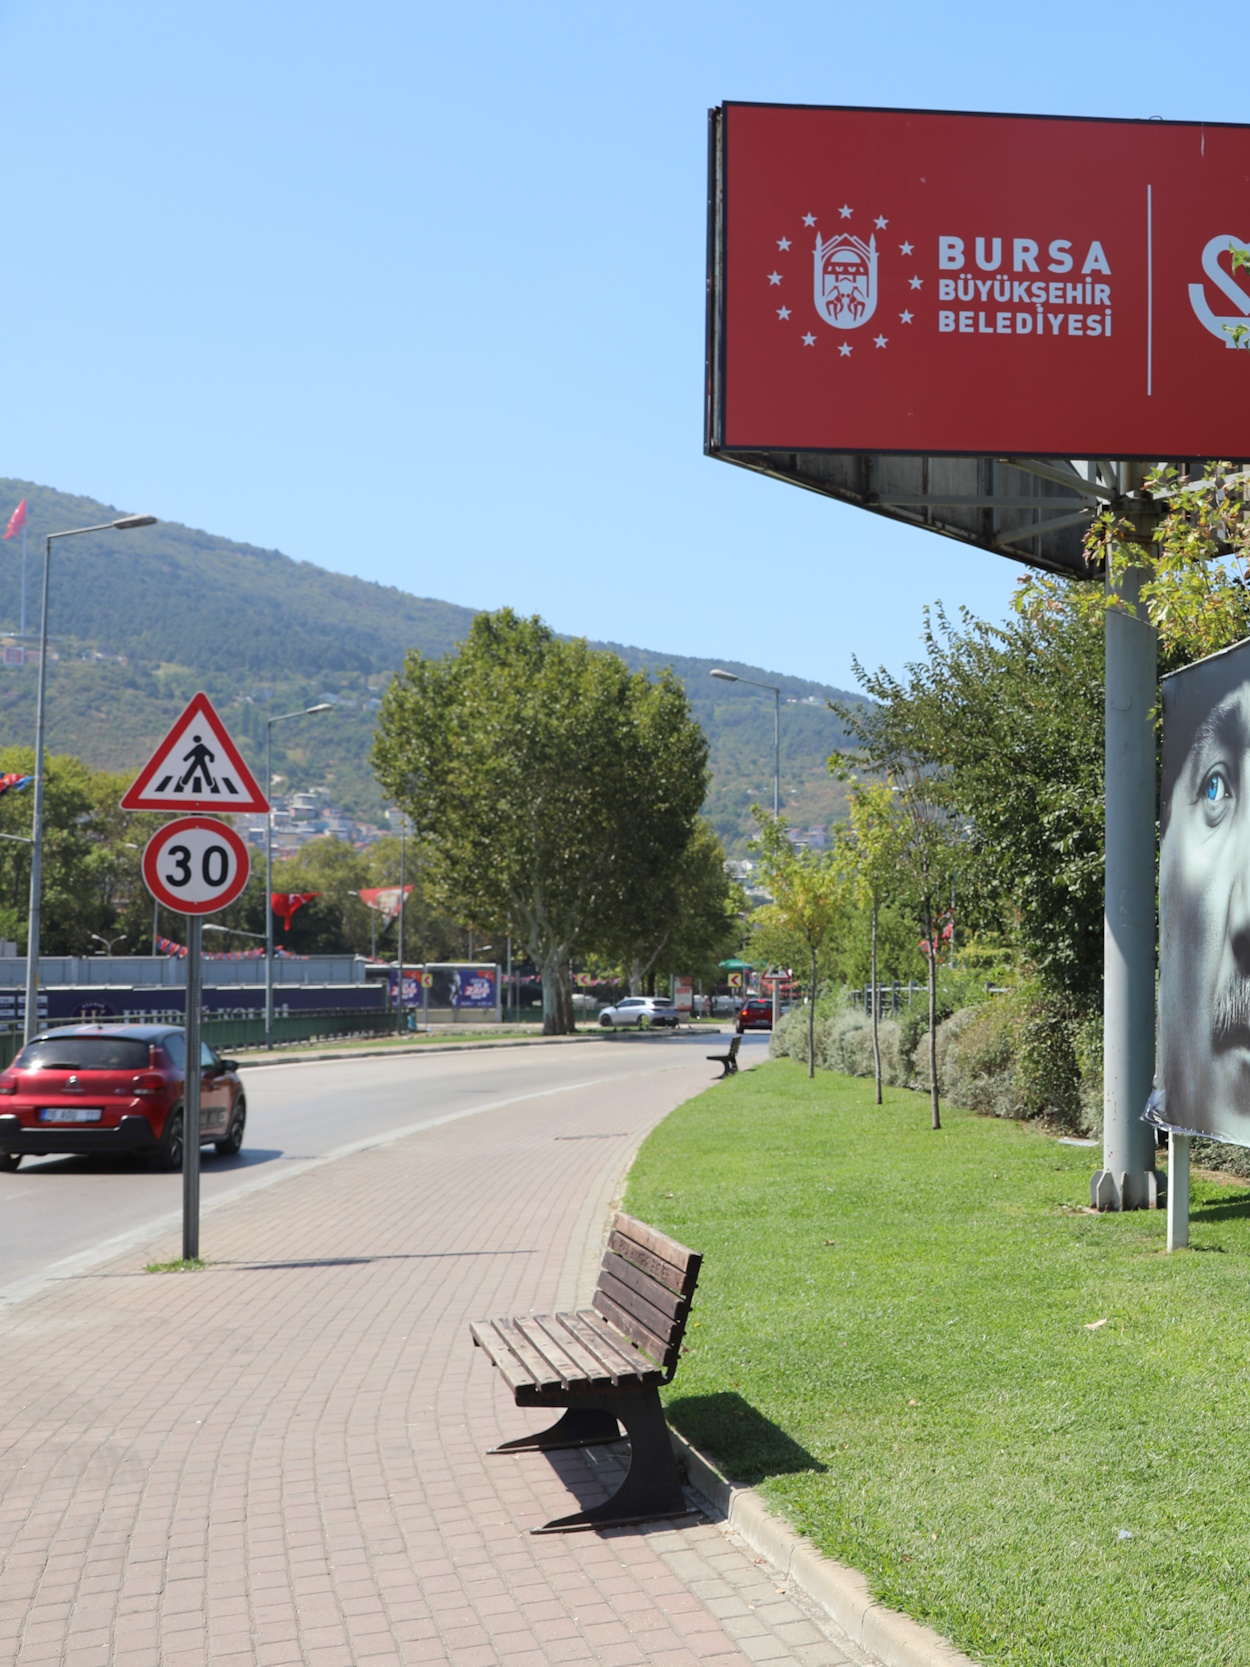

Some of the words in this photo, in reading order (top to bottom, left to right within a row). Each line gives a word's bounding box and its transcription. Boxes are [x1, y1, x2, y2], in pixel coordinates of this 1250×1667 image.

[938, 235, 1112, 275] BURSA
[938, 274, 1112, 308] BÜYÜKŞEHİR
[938, 307, 1112, 337] BELEDİYESİ
[165, 845, 229, 888] 30
